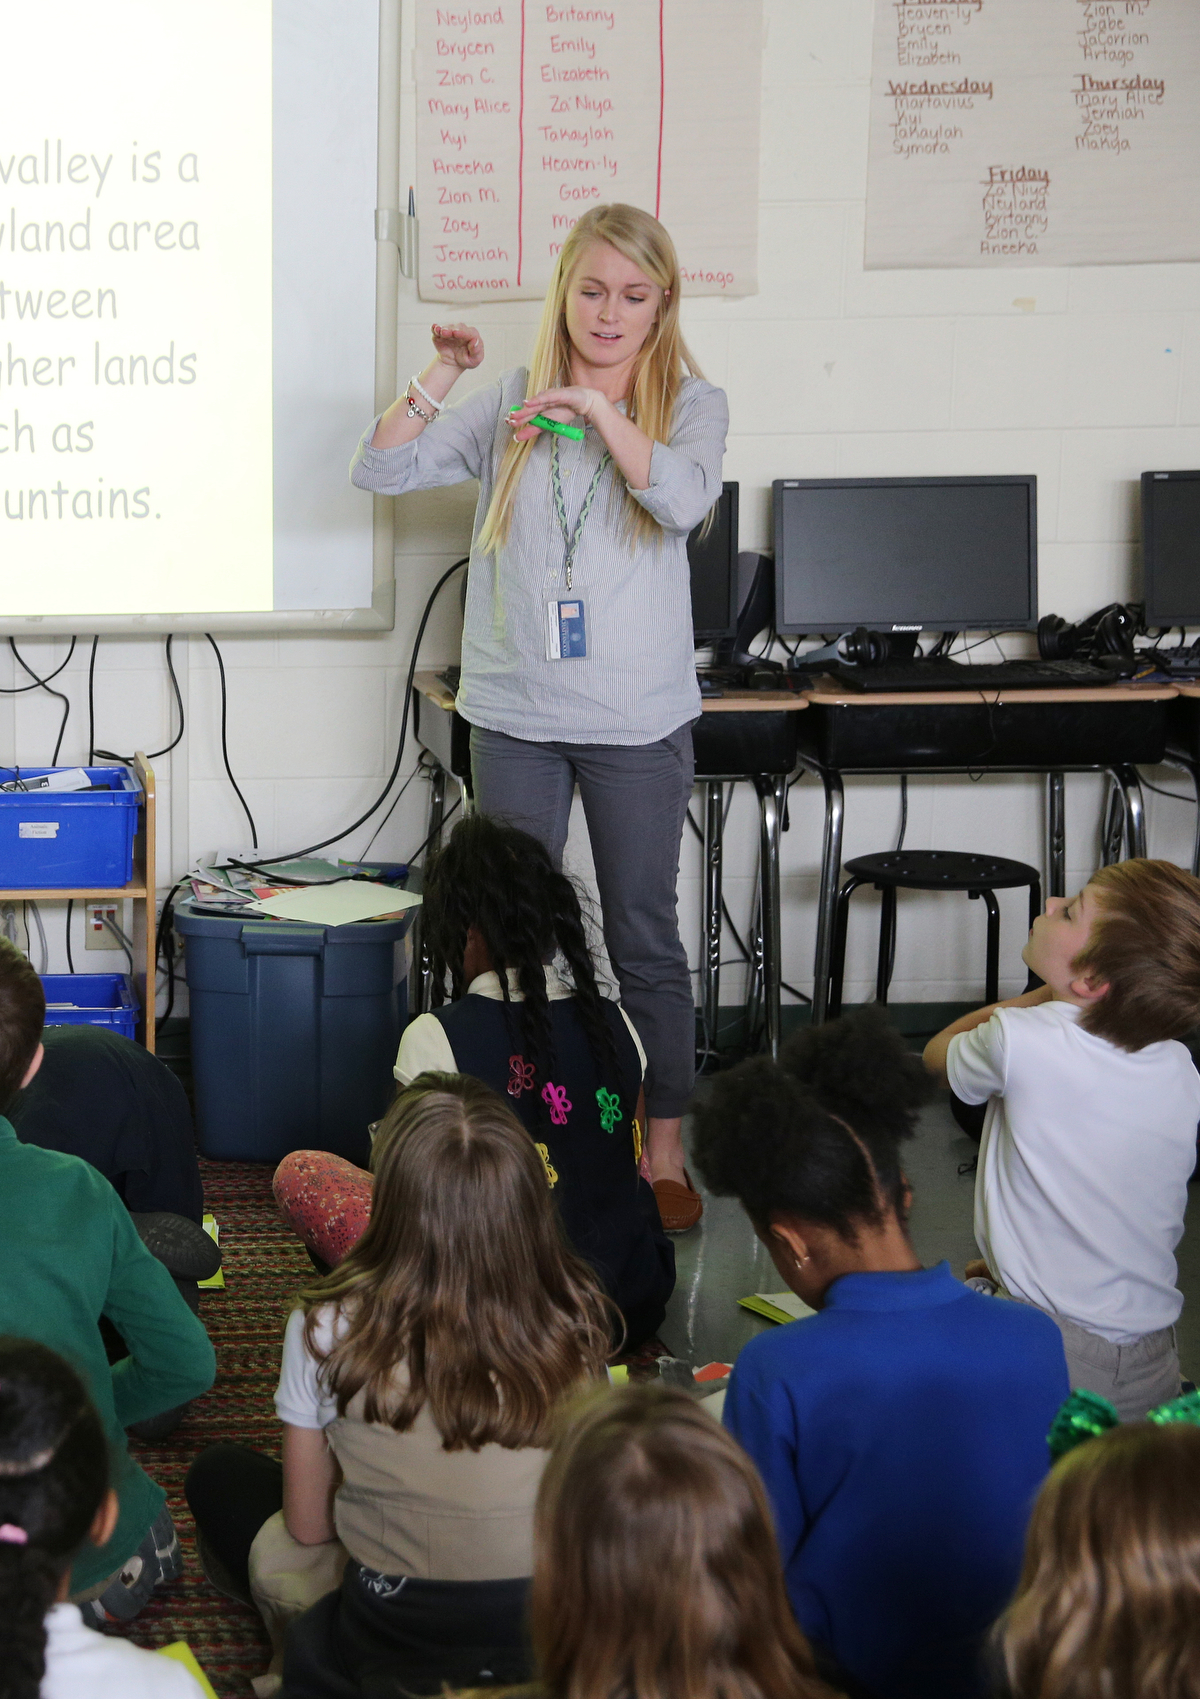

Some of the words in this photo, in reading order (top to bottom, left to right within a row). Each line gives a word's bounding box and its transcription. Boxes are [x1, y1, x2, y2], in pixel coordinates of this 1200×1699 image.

[436, 6, 505, 33] Neyland
[546, 4, 615, 30] Britanny
[1081, 1, 1115, 17] Zion
[898, 20, 952, 40] Brycen
[1086, 15, 1125, 32] Gabe
[436, 38, 494, 62] Brycen
[550, 34, 596, 60] Emily
[897, 36, 938, 55] Emily
[1083, 45, 1134, 68] Artago
[898, 51, 961, 67] Elizabeth
[436, 69, 473, 86] Zion
[480, 66, 495, 84] C.
[540, 63, 610, 82] Elizabeth
[887, 77, 993, 100] Wednesday
[1073, 73, 1165, 98] Thursday
[428, 98, 469, 120] Mary
[474, 97, 511, 114] Alice
[1074, 91, 1118, 109] Mary
[1126, 89, 1164, 106] Alice
[1079, 104, 1144, 121] Jermiah
[440, 129, 467, 151] Kyi
[1082, 120, 1119, 140] Zoey
[132, 141, 161, 183] is
[178, 151, 199, 183] a
[542, 154, 618, 178] Heaven-ly
[987, 165, 1049, 187] Friday
[437, 186, 472, 205] Zion
[479, 187, 500, 203] M.
[559, 183, 601, 201] Gabe
[108, 220, 200, 252] area
[441, 215, 479, 239] Zoey
[985, 223, 1018, 240] Zion
[432, 244, 509, 262] Jermiah
[94, 340, 197, 386] lands
[52, 420, 94, 453] as
[892, 624, 923, 632] lenovo
